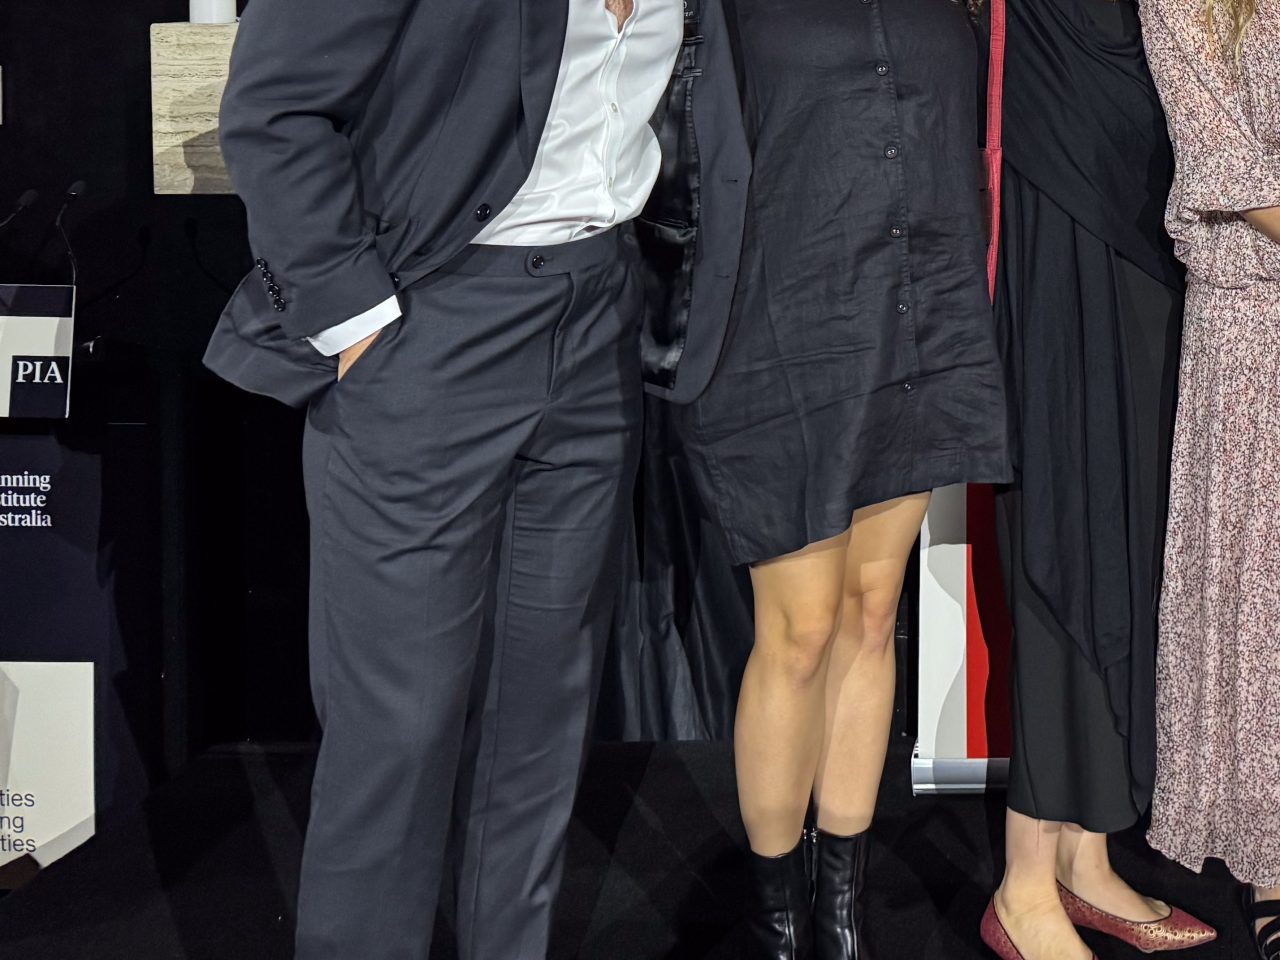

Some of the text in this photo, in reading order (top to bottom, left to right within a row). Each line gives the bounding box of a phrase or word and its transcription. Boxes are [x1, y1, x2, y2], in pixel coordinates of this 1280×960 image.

[15, 360, 63, 383] PIA
[0, 470, 51, 491] nning
[0, 490, 47, 508] titute
[0, 510, 52, 528] stralia
[0, 789, 35, 807] ties
[0, 815, 25, 834] ng
[0, 834, 37, 853] ties
